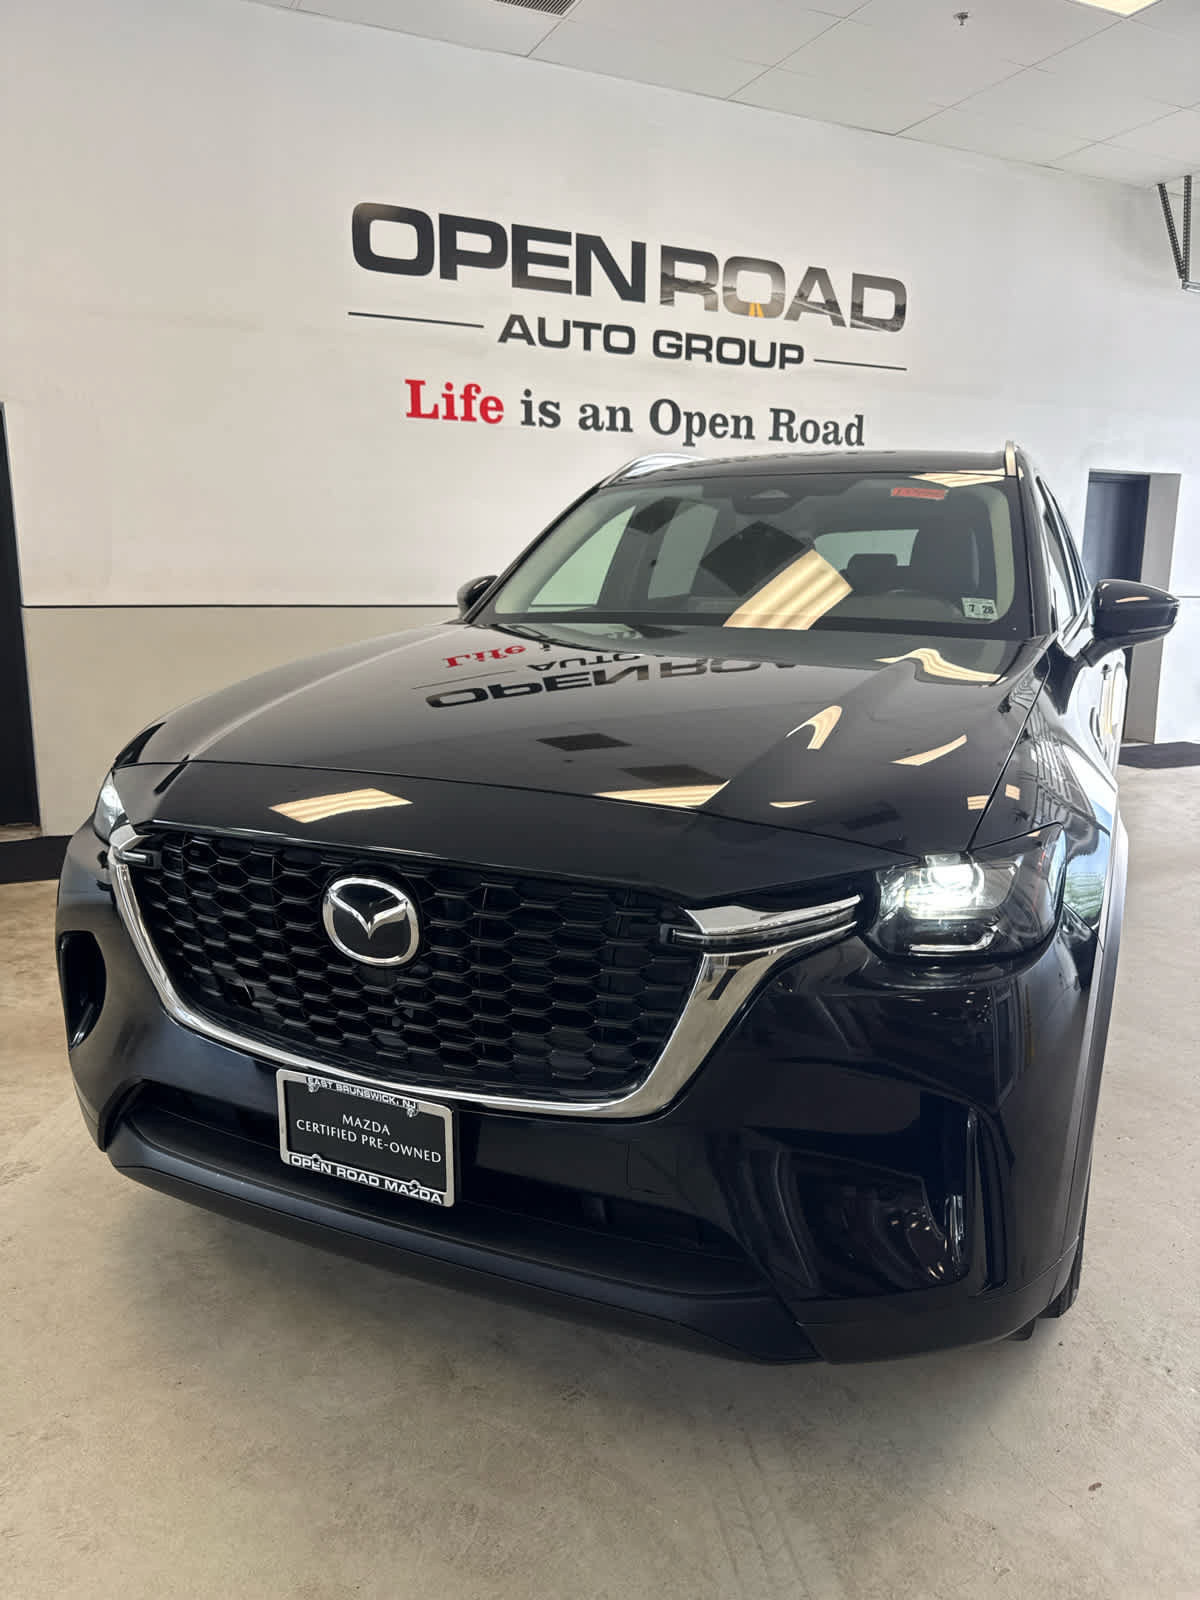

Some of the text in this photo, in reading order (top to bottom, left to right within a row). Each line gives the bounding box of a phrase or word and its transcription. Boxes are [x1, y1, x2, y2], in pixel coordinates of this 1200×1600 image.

[351, 202, 907, 333] OPEN ROAD
[497, 313, 805, 370] AUTO GROUP
[405, 378, 865, 448] Life is an Open Road
[296, 1119, 441, 1163] CERTIFIED PRE-OWNED
[342, 1114, 391, 1136] MAZDA
[291, 1155, 442, 1204] OPEN ROAD MAZDA
